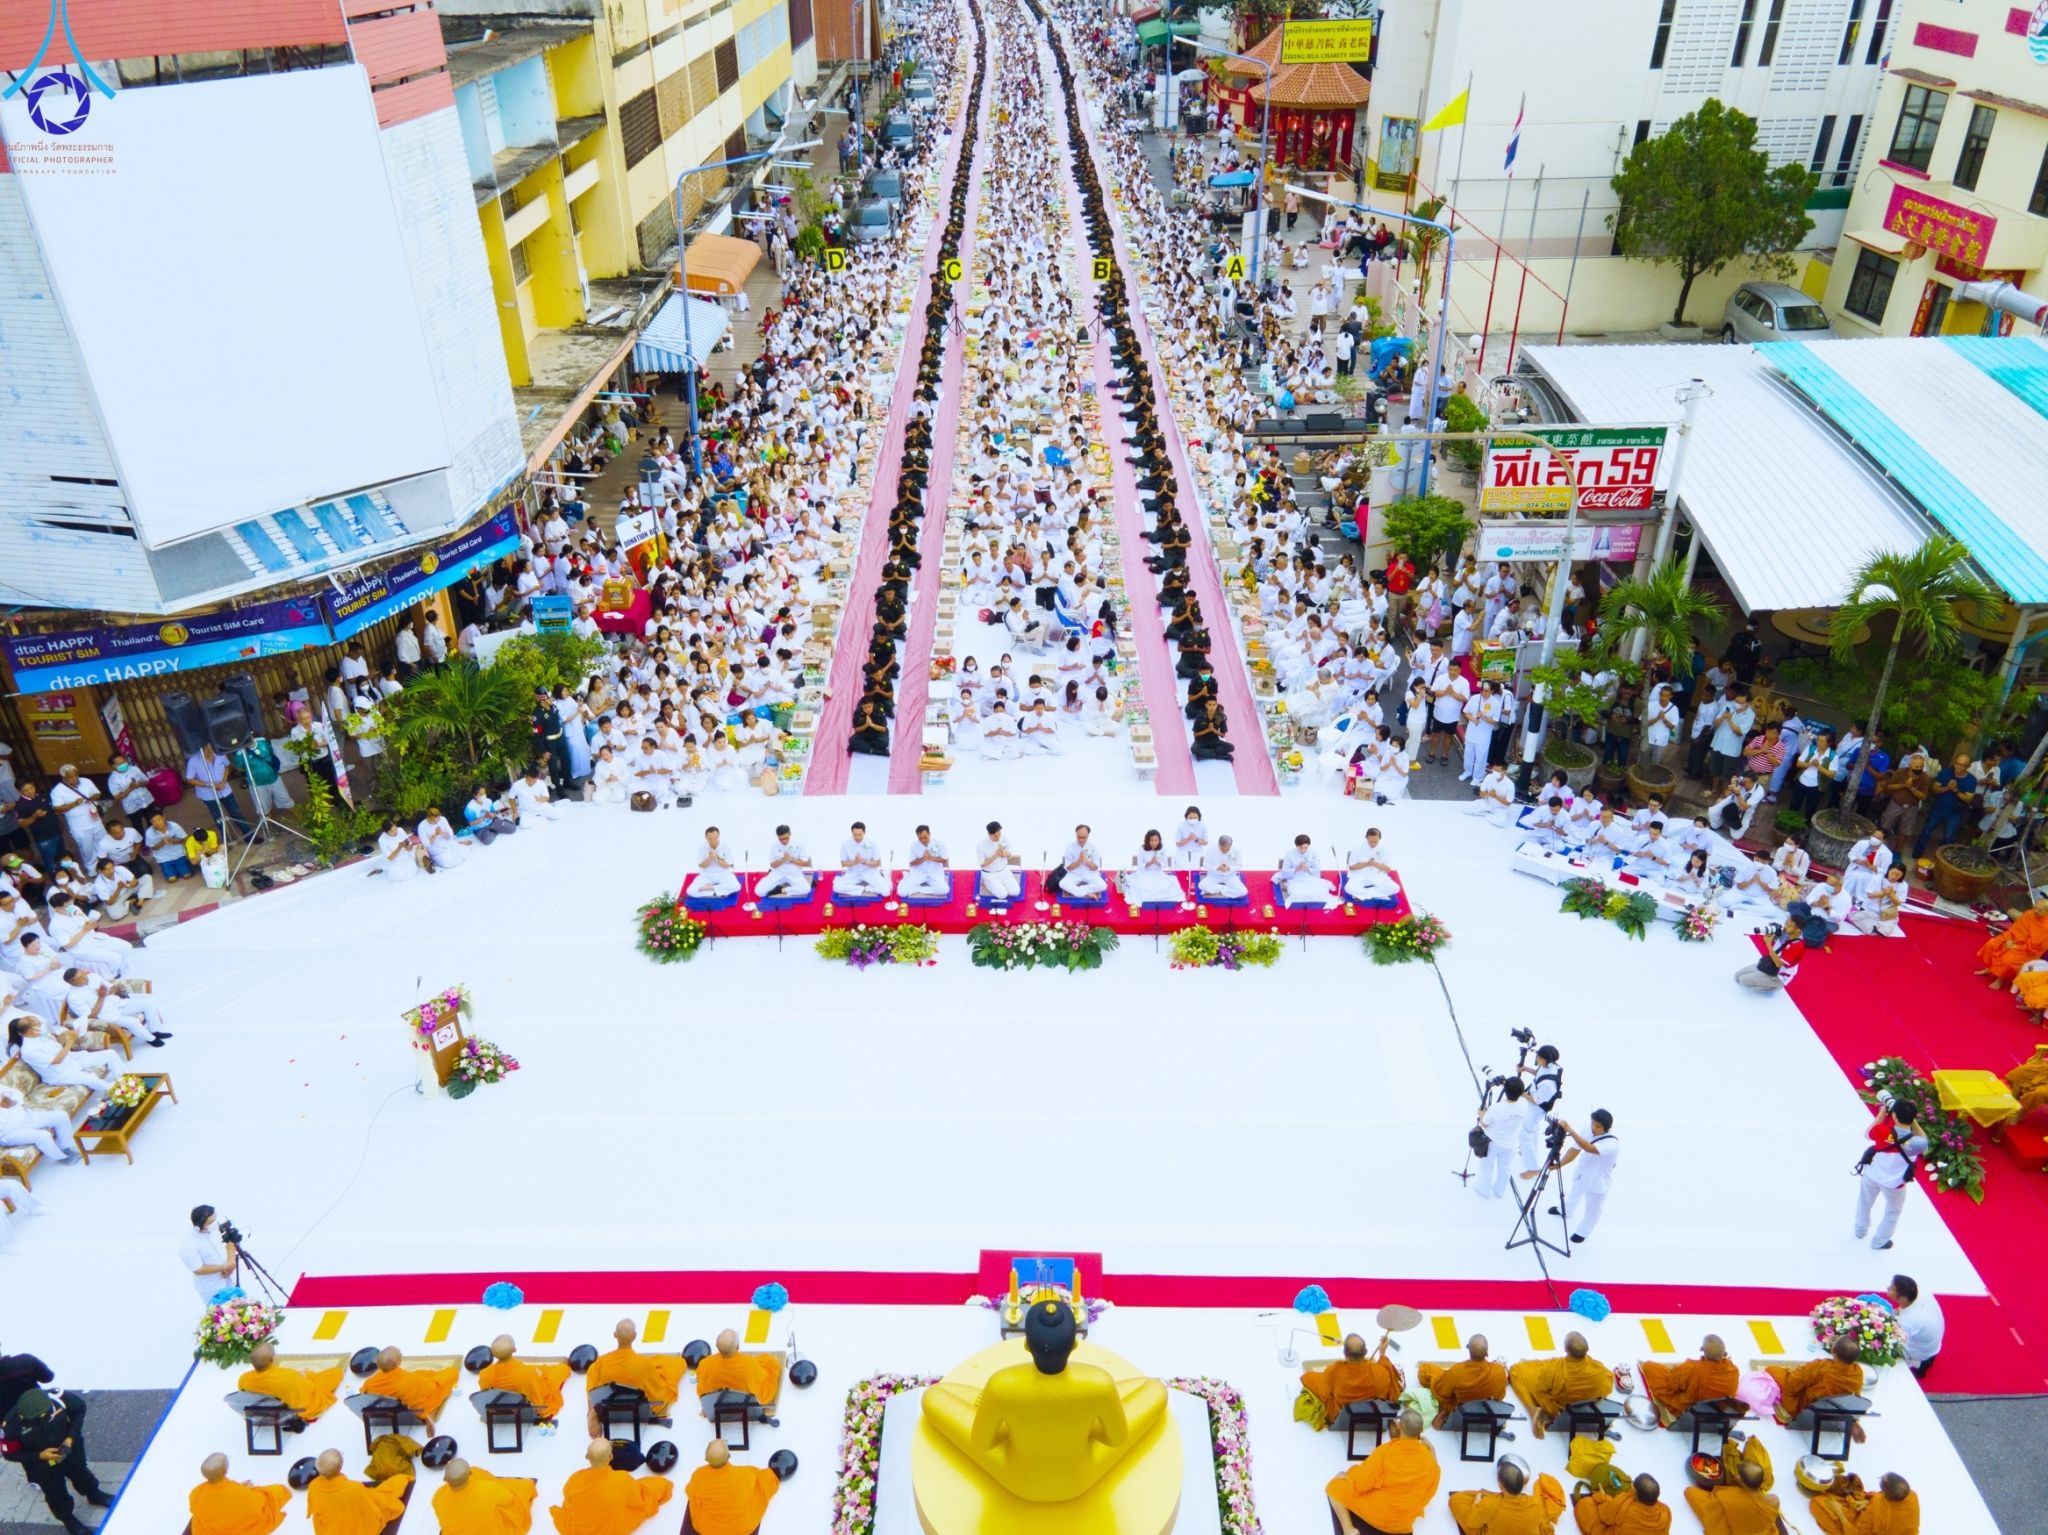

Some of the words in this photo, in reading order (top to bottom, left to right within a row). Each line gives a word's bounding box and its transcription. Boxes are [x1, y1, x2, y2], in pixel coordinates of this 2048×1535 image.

[828, 251, 844, 270] D
[946, 261, 962, 280] C
[1093, 261, 1109, 279] B
[1228, 258, 1244, 278] A
[1491, 449, 1604, 487] พี่เล็ก
[1607, 447, 1659, 486] 59
[1577, 487, 1648, 507] Coca-Cola
[439, 548, 458, 561] Tourist
[458, 543, 469, 553] SIM
[469, 536, 483, 548] Card
[623, 531, 649, 548] DONATION
[392, 566, 422, 584] Thailand's
[333, 593, 353, 608] dtac
[353, 576, 383, 597] HAPPY
[336, 595, 371, 618] TOURIST
[372, 587, 387, 600] SIM
[111, 634, 160, 648] Thailand's
[190, 623, 222, 635] Tourist
[223, 621, 242, 630] SIM
[242, 617, 265, 627] Card
[15, 645, 45, 656] dtac
[47, 635, 94, 651] HAPPY
[18, 651, 73, 666] TOURIST
[76, 647, 101, 659] SIM
[49, 673, 100, 691] dtac
[104, 657, 181, 683] HAPPY
